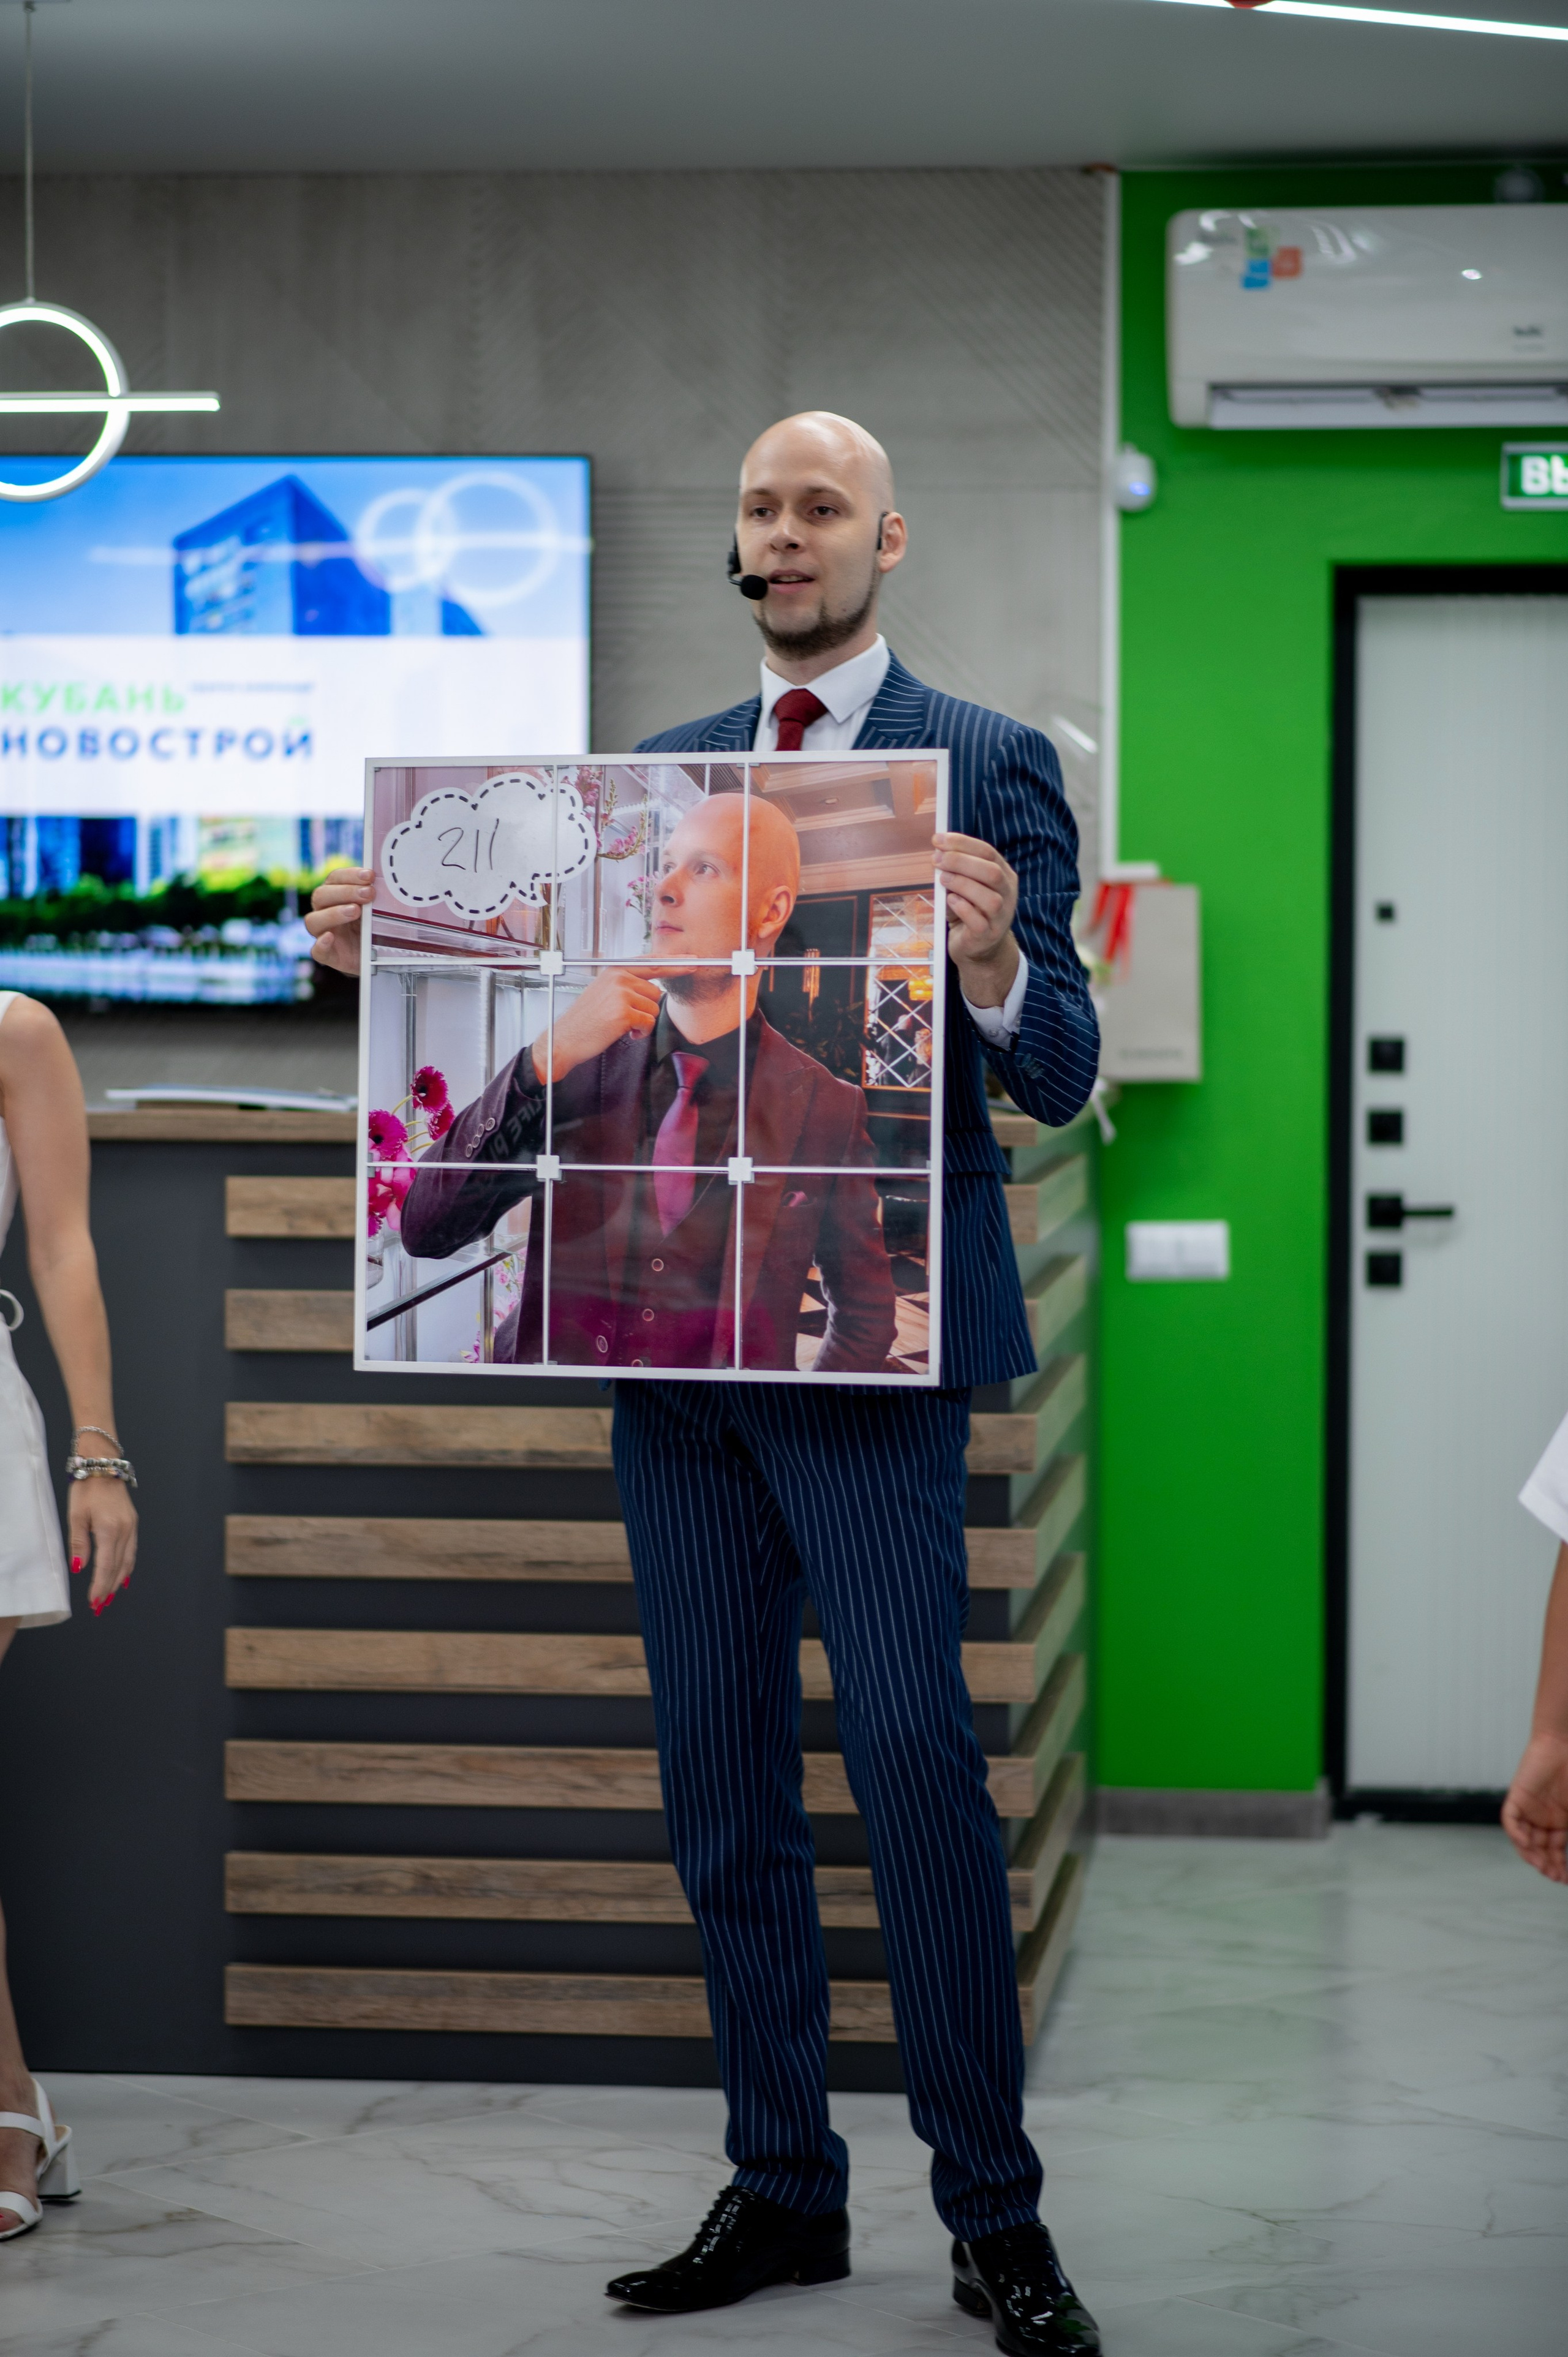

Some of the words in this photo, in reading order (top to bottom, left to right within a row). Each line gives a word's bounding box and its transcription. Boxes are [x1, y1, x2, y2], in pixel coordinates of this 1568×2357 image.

[0, 680, 187, 714] КУБАНЬ
[0, 716, 314, 761] НОВОСТРОЙ
[437, 818, 500, 873] 211
